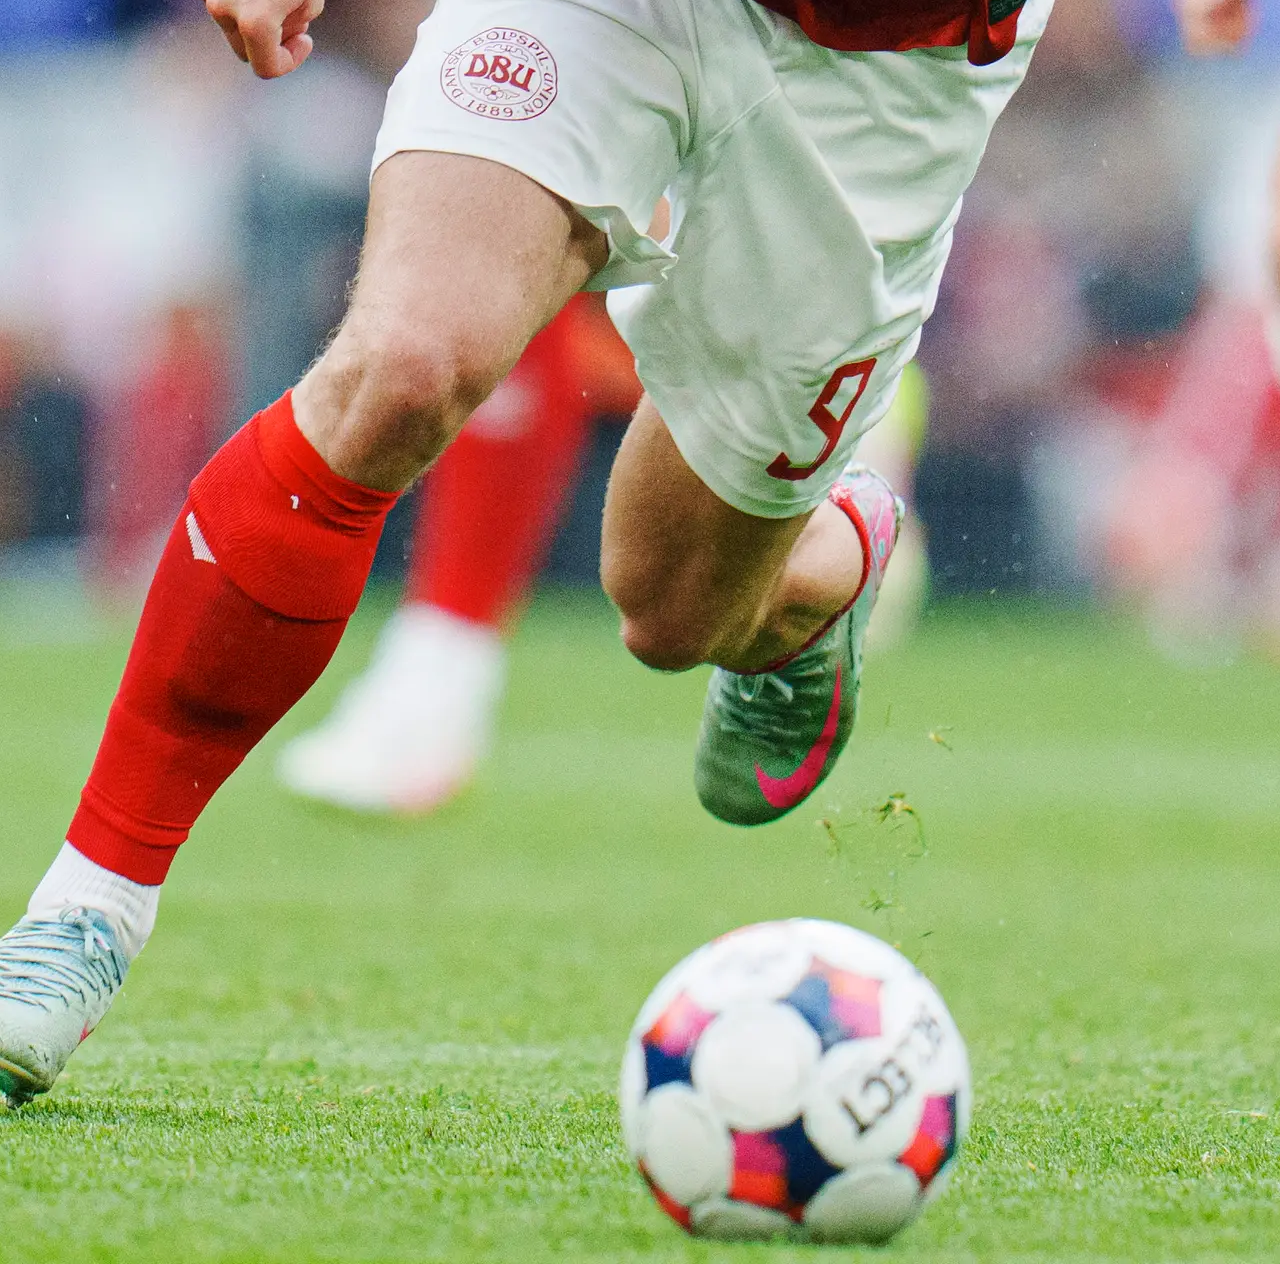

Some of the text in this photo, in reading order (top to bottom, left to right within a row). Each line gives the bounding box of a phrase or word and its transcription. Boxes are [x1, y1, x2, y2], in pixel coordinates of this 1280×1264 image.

[445, 47, 469, 99] DANSK
[463, 53, 536, 92] DBU
[467, 99, 514, 118] 1889
[765, 357, 877, 481] 9
